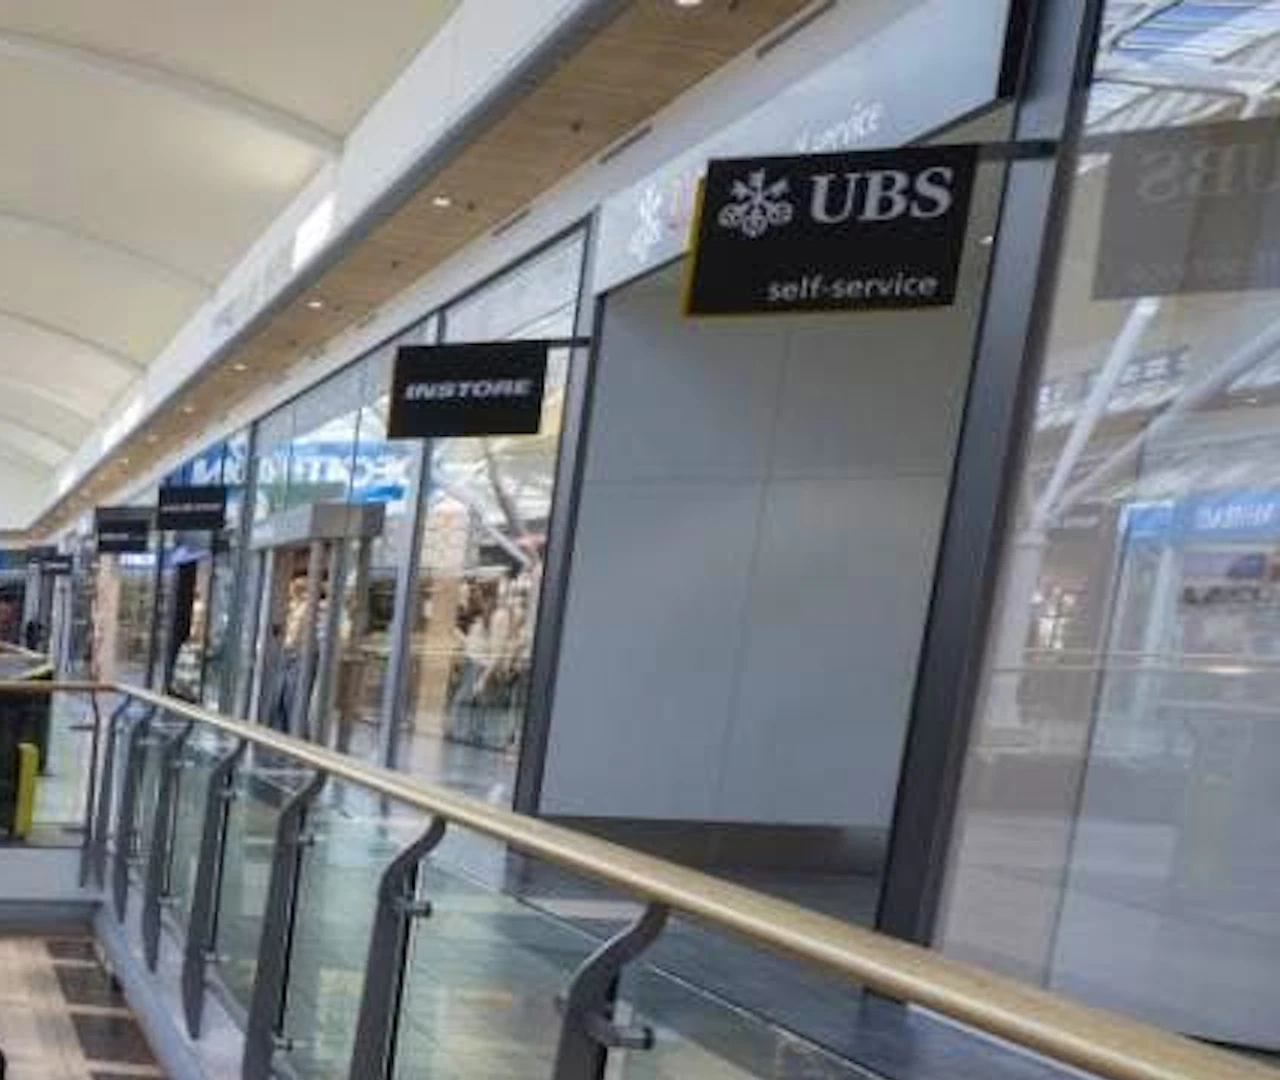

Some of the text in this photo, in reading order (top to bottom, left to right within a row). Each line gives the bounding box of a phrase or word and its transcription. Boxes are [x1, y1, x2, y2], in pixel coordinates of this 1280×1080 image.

[808, 166, 956, 224] UBS
[768, 272, 940, 301] self-service
[405, 379, 534, 401] INSTORE
